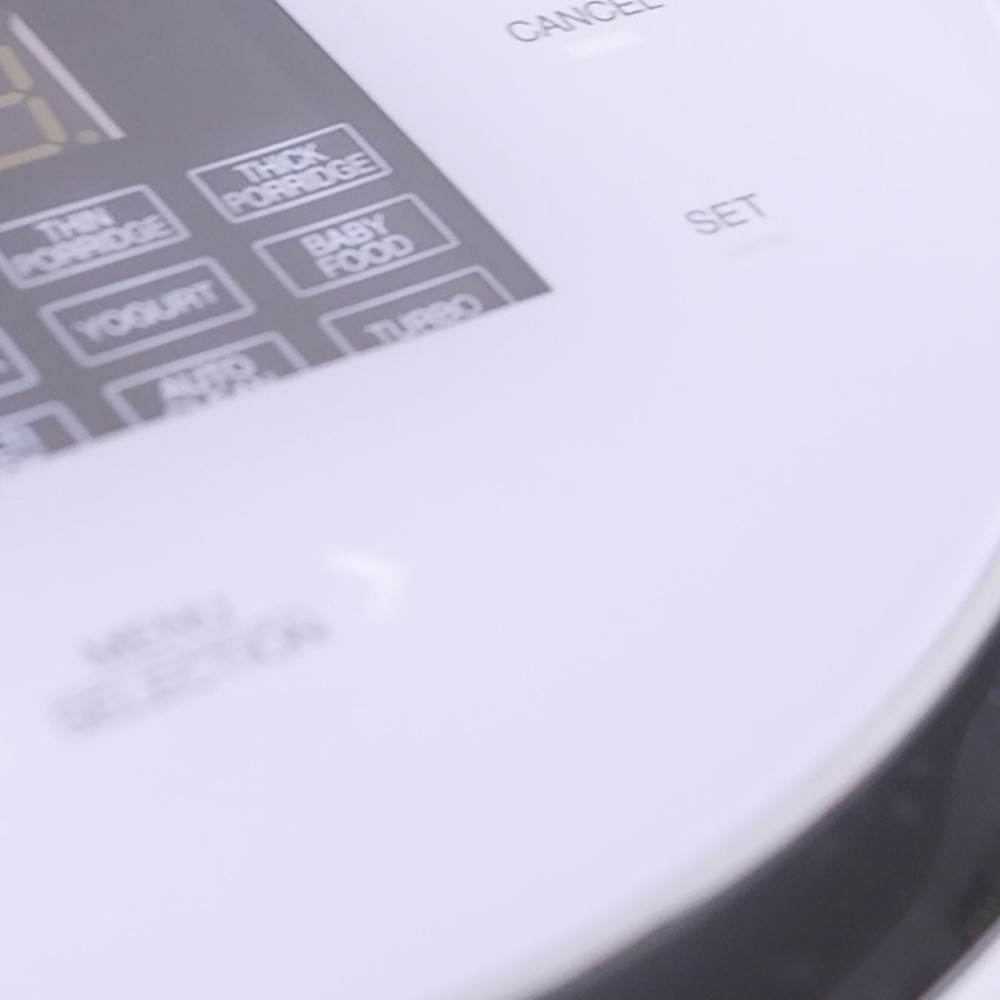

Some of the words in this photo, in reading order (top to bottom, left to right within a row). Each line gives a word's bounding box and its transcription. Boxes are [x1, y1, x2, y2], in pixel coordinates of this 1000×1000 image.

[221, 152, 378, 214] PORRIDGE
[232, 143, 329, 184] THICK
[299, 213, 390, 258] BABY
[684, 192, 767, 236] SET
[10, 213, 173, 278] PORRIDGE
[316, 233, 414, 278] FOOD
[71, 279, 219, 341] YOGURT
[364, 293, 485, 342] TURBO
